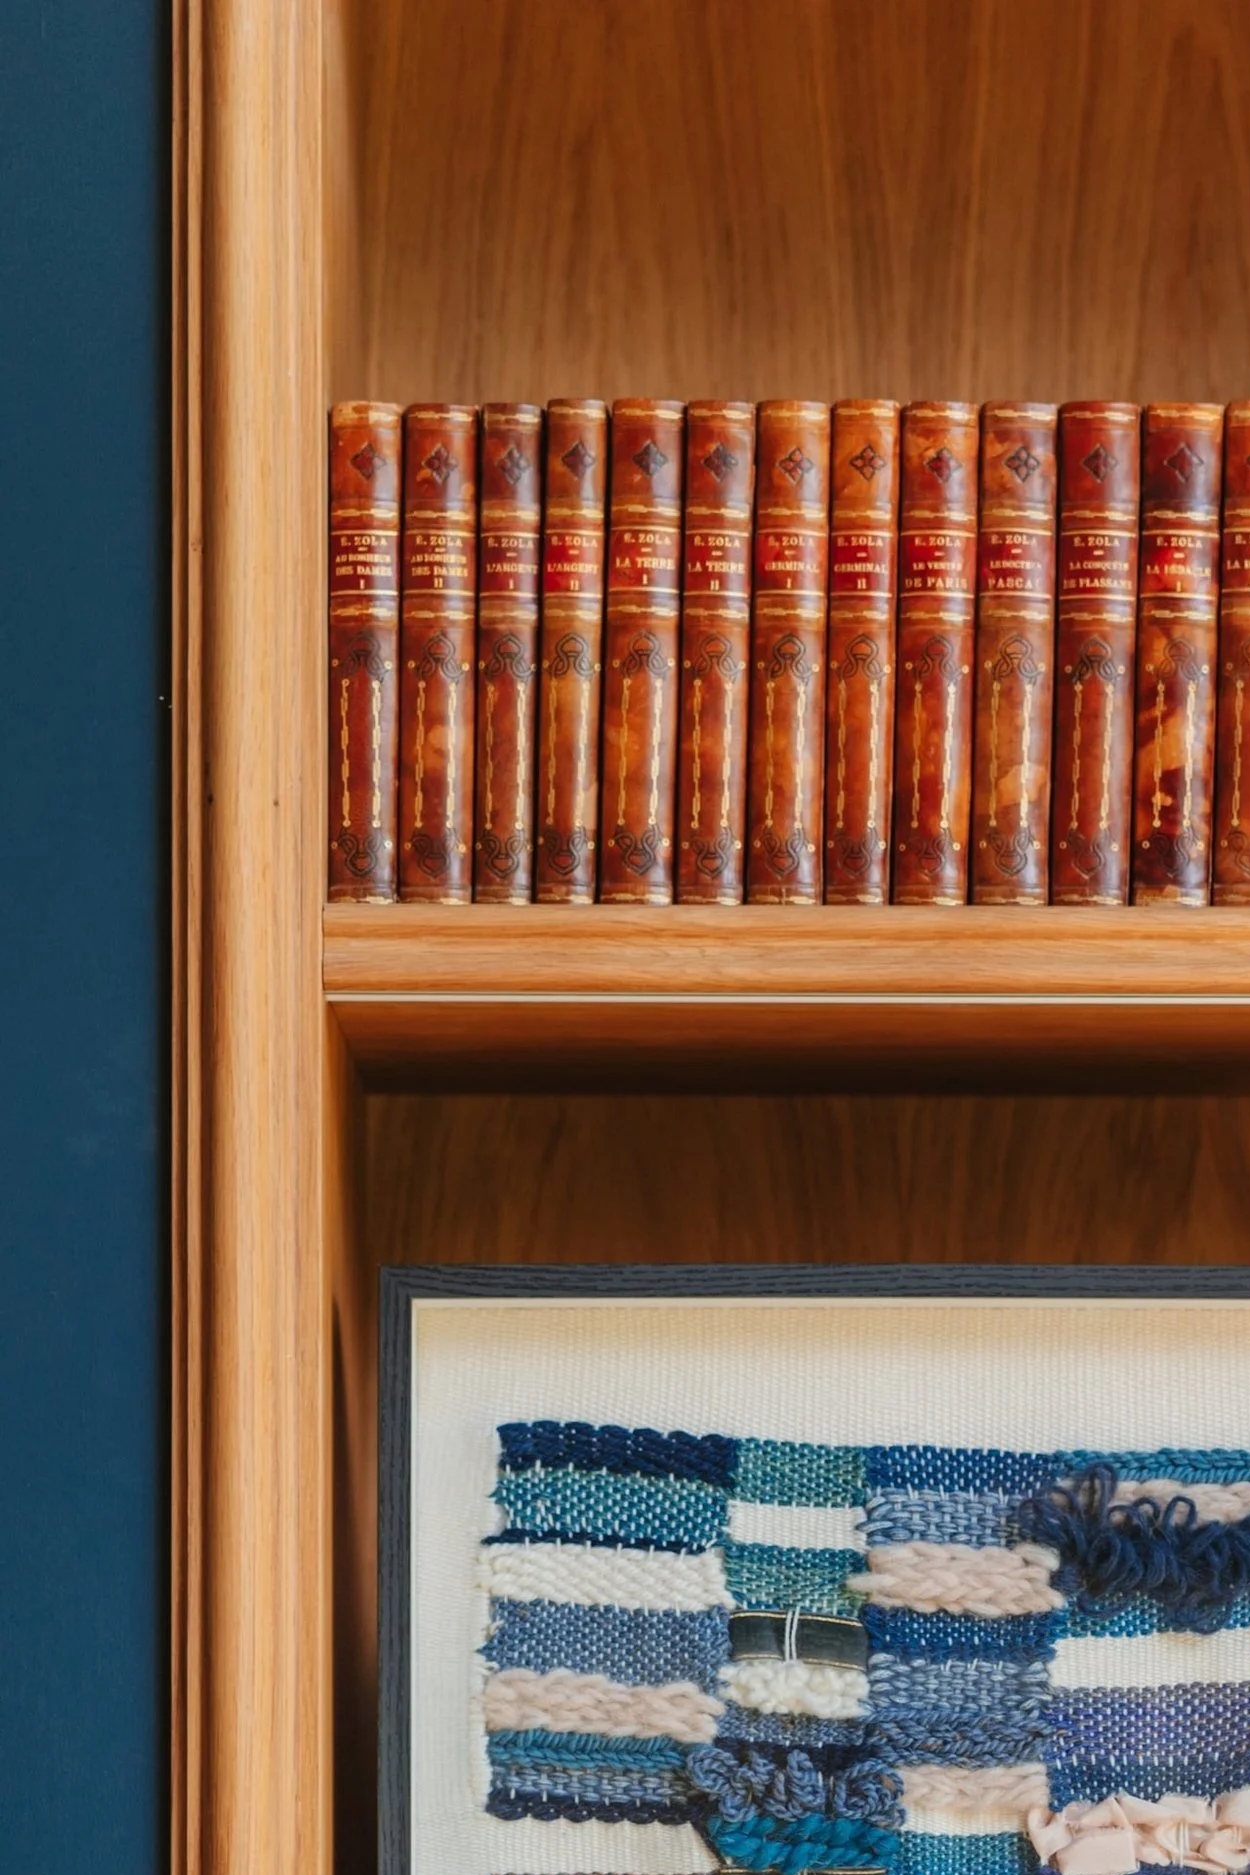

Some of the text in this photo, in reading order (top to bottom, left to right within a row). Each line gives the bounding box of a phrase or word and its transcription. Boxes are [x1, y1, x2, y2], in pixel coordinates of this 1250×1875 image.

[354, 536, 387, 546] ZOLA
[430, 536, 463, 547] ZOLA
[501, 538, 534, 549] ZOLA
[565, 536, 598, 547] ZOLA
[639, 533, 671, 545] ZOLA
[708, 536, 740, 548] ZOLA
[782, 536, 815, 547] ZOLA
[851, 536, 883, 547] ZOLA
[929, 537, 961, 547] ZOLA
[1005, 535, 1038, 545] ZOLA
[1088, 536, 1120, 547] ZOLA
[1171, 537, 1203, 548] ZOLA
